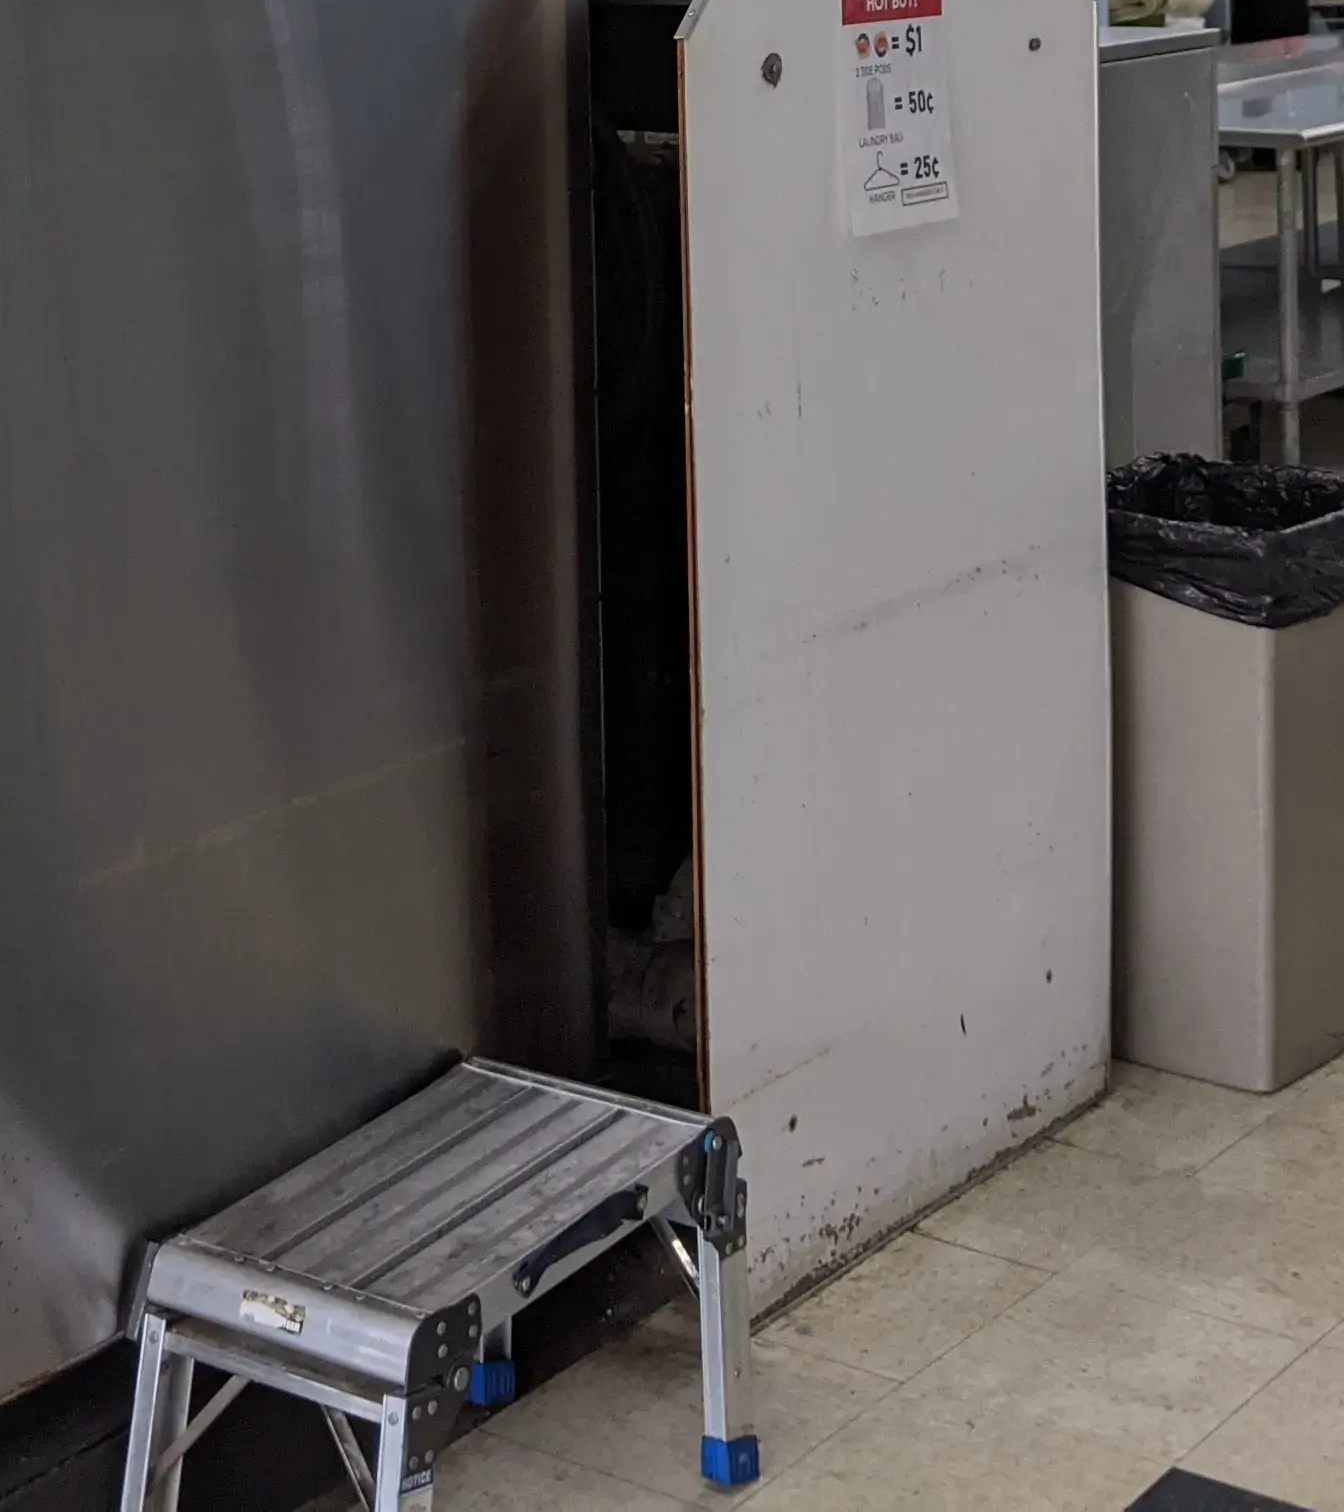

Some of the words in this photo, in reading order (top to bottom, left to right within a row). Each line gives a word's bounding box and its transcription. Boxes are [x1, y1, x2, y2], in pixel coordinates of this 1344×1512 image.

[905, 23, 922, 57] $1
[908, 90, 934, 114] 50¢
[914, 155, 940, 179] 25¢
